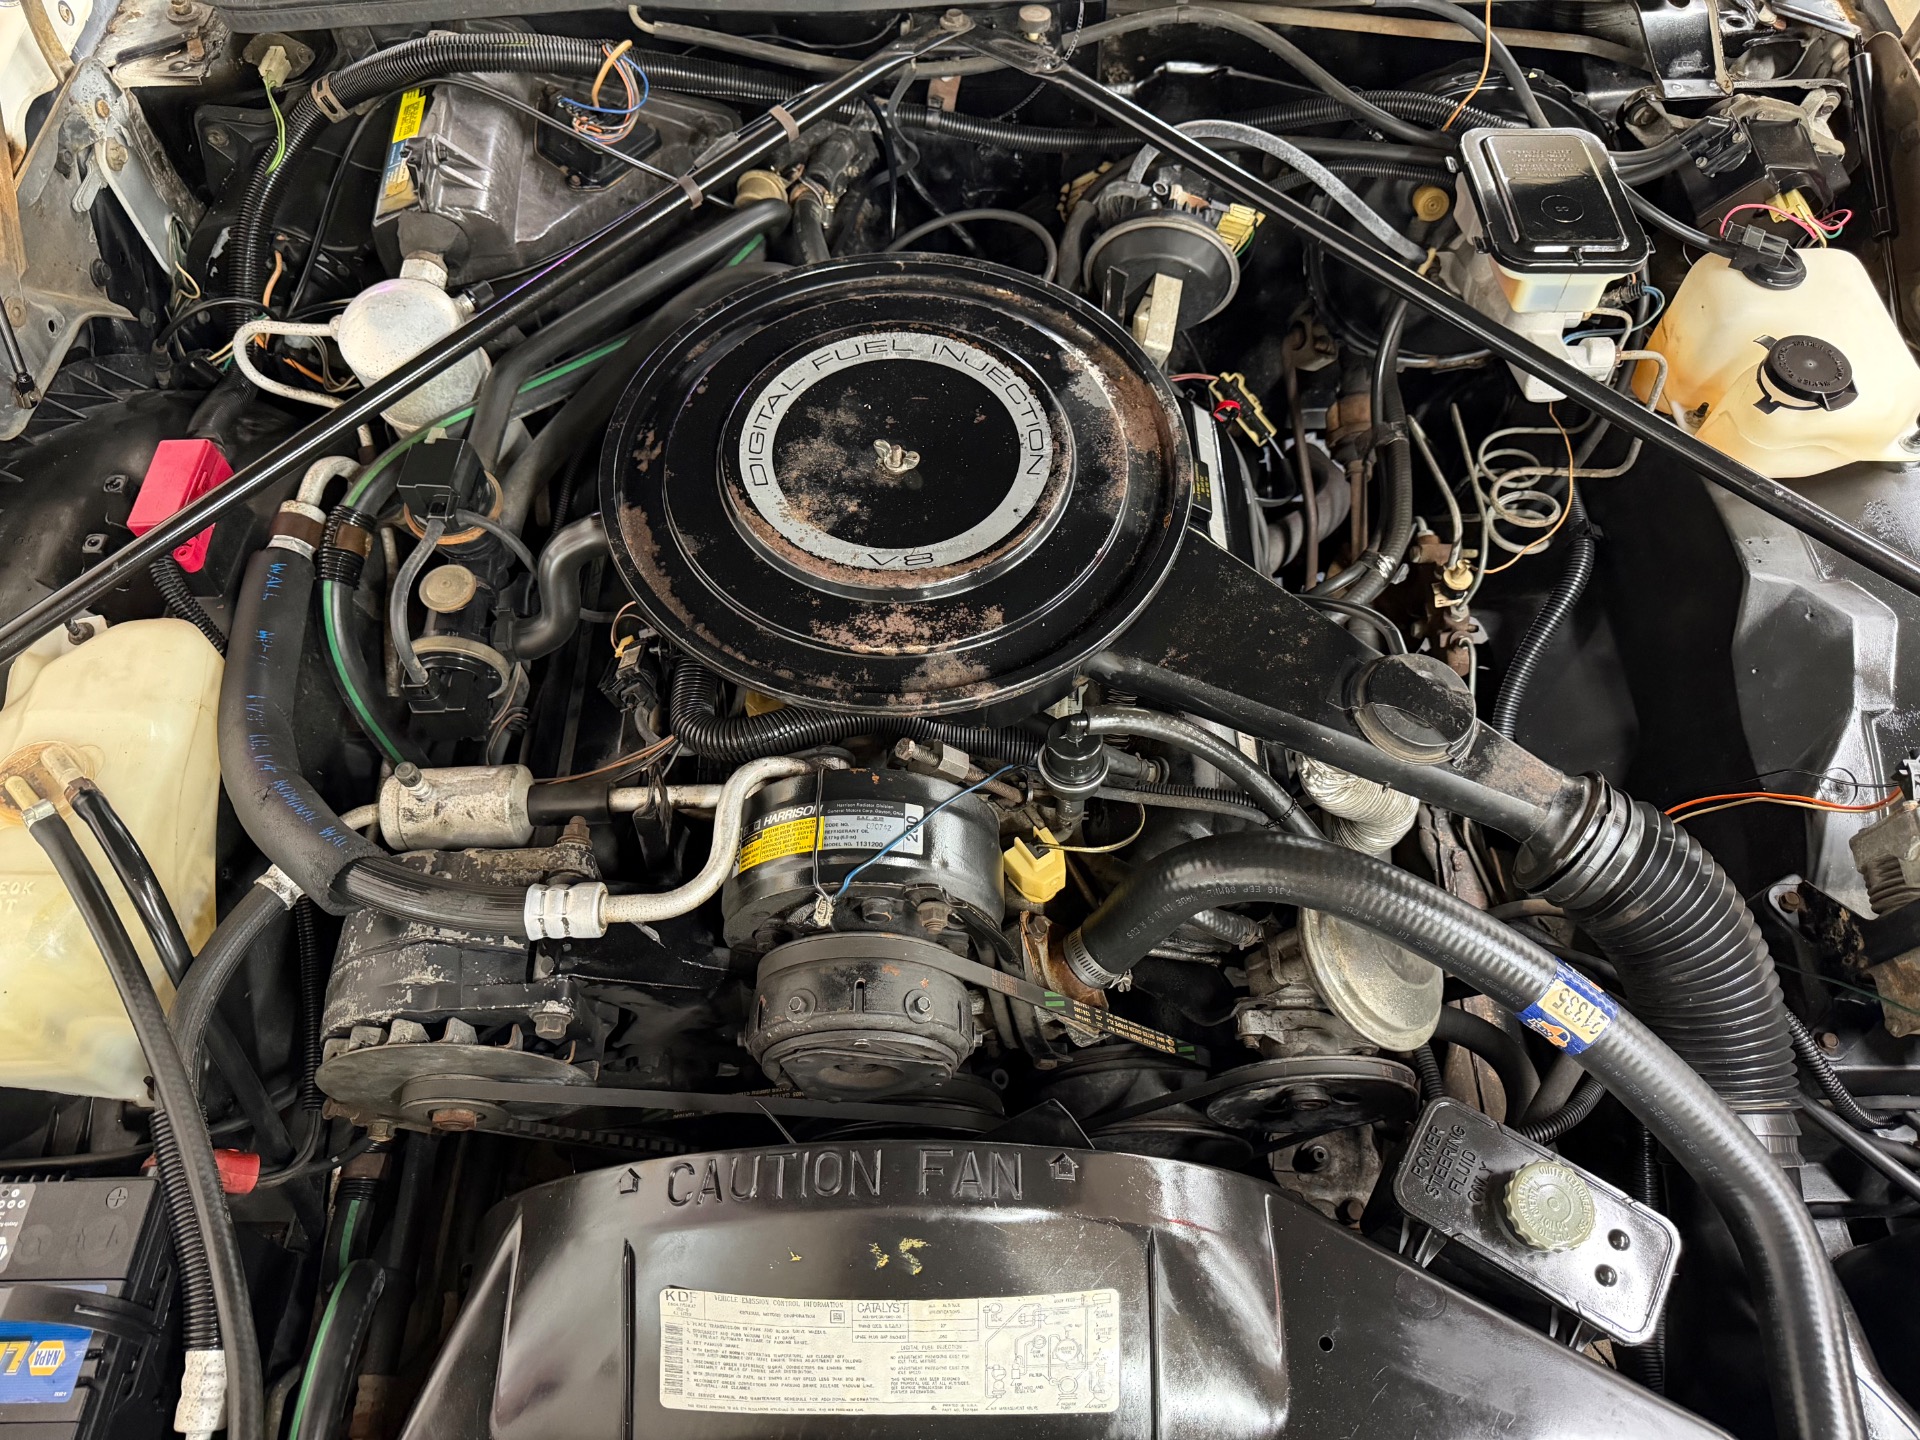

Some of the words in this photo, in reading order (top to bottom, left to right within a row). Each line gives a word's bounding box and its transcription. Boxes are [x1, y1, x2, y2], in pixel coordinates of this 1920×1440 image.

[748, 377, 806, 487] DIGITAL
[812, 338, 914, 371] FUEL
[932, 342, 1045, 475] INJECTION
[867, 552, 935, 567] V8
[763, 804, 824, 827] HARRISON
[1163, 903, 1174, 913] IN
[1551, 987, 1608, 1035] 21335
[1410, 1124, 1442, 1181] POWER
[1424, 1124, 1466, 1200] STEERING
[666, 1148, 882, 1207] CAUTION
[918, 1149, 1023, 1201] FAN
[1448, 1149, 1477, 1196] FLUID
[1467, 1160, 1494, 1205] ONLY
[1538, 1165, 1566, 1179] FLUID
[714, 1294, 739, 1303] VEHICLE
[741, 1297, 769, 1306] EMISSION
[772, 1299, 800, 1307] CONTROL
[857, 1302, 908, 1313] CATALYST
[33, 1349, 61, 1367] NAPA
